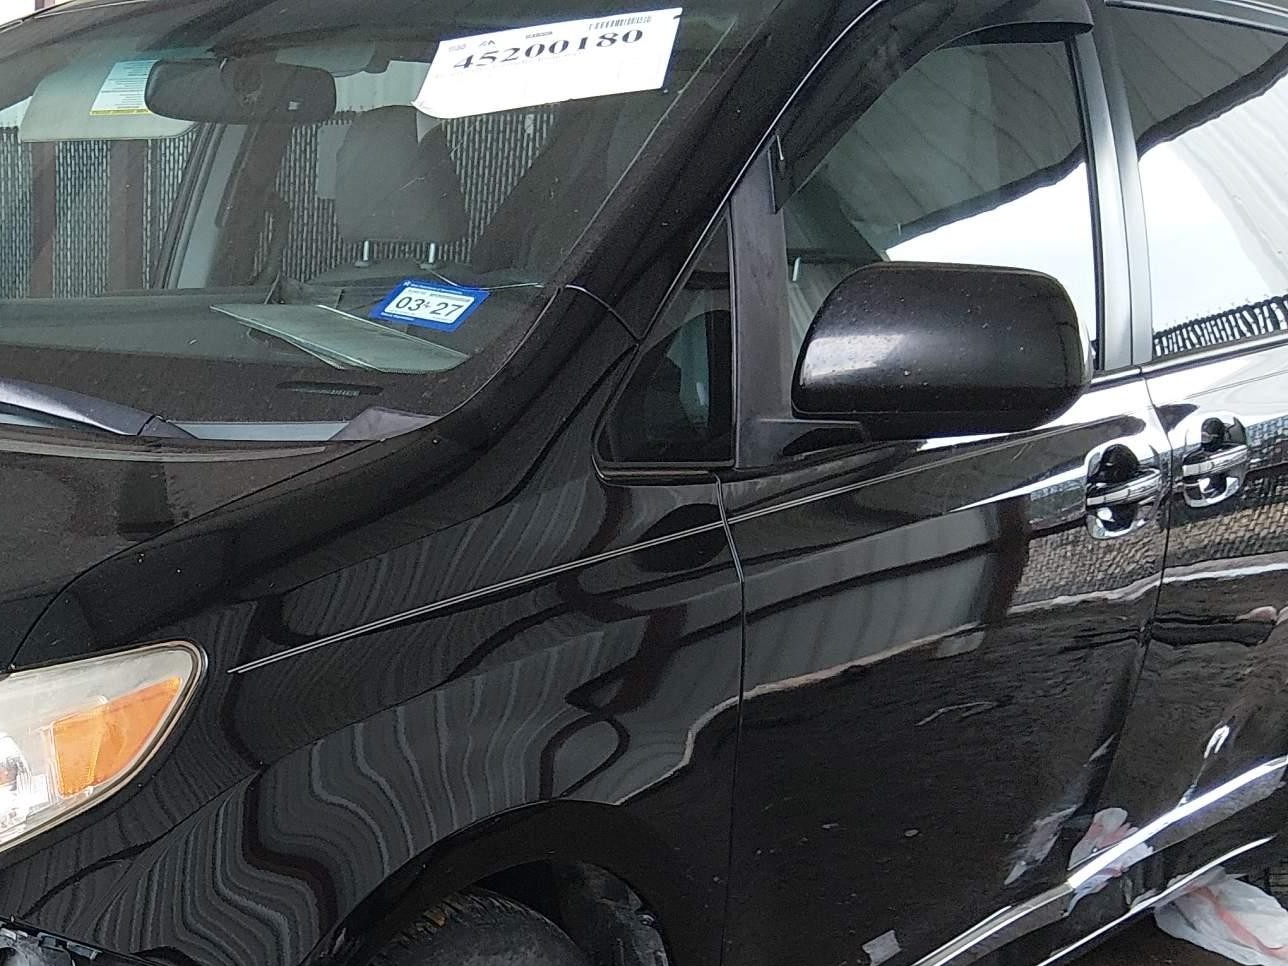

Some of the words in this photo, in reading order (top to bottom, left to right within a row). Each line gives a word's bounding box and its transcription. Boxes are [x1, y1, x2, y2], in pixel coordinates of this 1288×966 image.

[452, 29, 643, 69] 45200180
[395, 296, 425, 312] 03
[429, 302, 465, 317] 27
